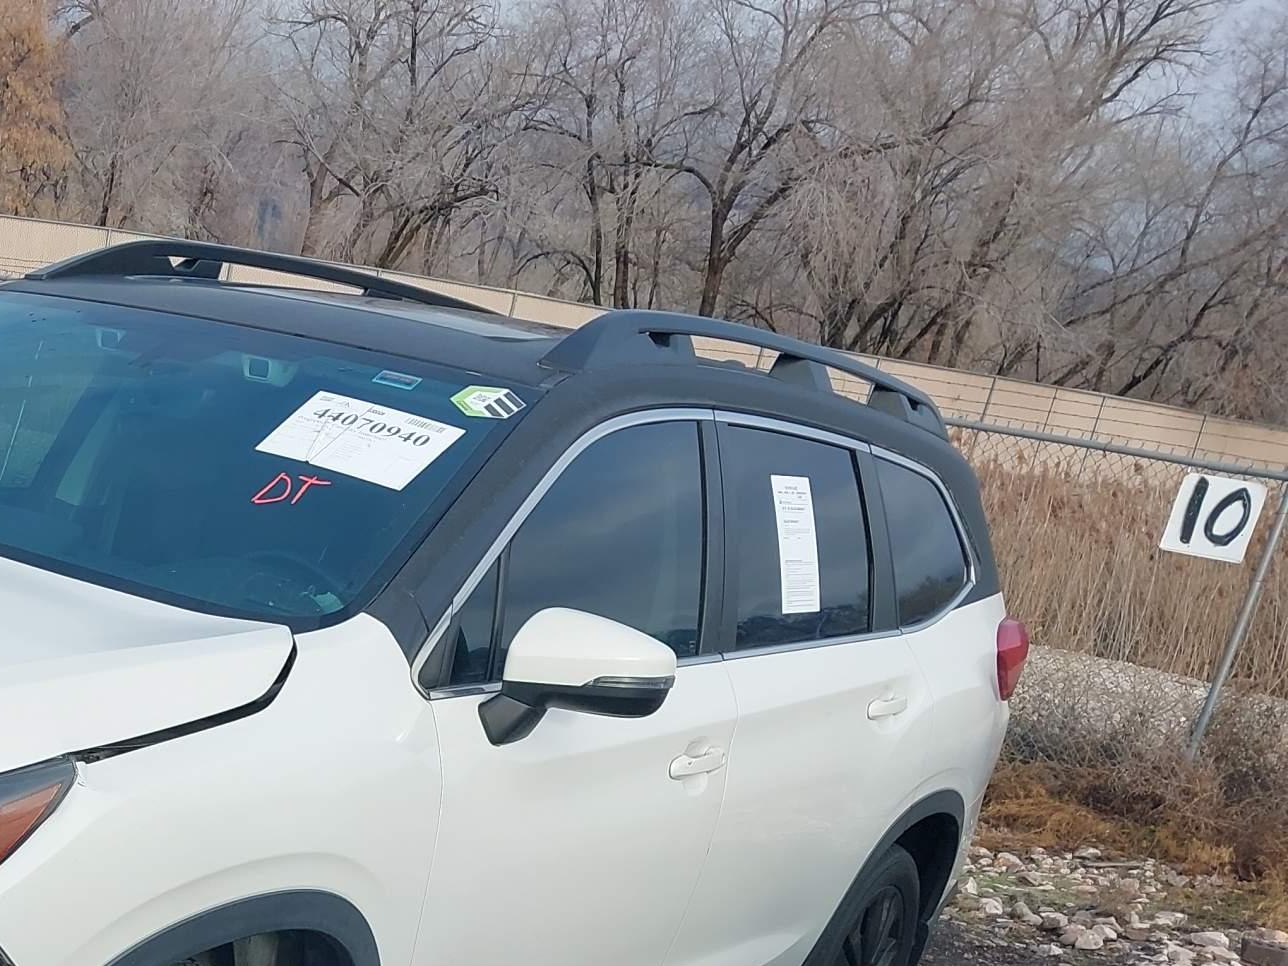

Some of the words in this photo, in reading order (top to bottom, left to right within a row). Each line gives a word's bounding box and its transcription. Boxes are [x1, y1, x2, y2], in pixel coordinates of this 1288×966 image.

[313, 408, 430, 447] 44070940
[250, 471, 332, 505] DT
[1179, 475, 1252, 547] 10
